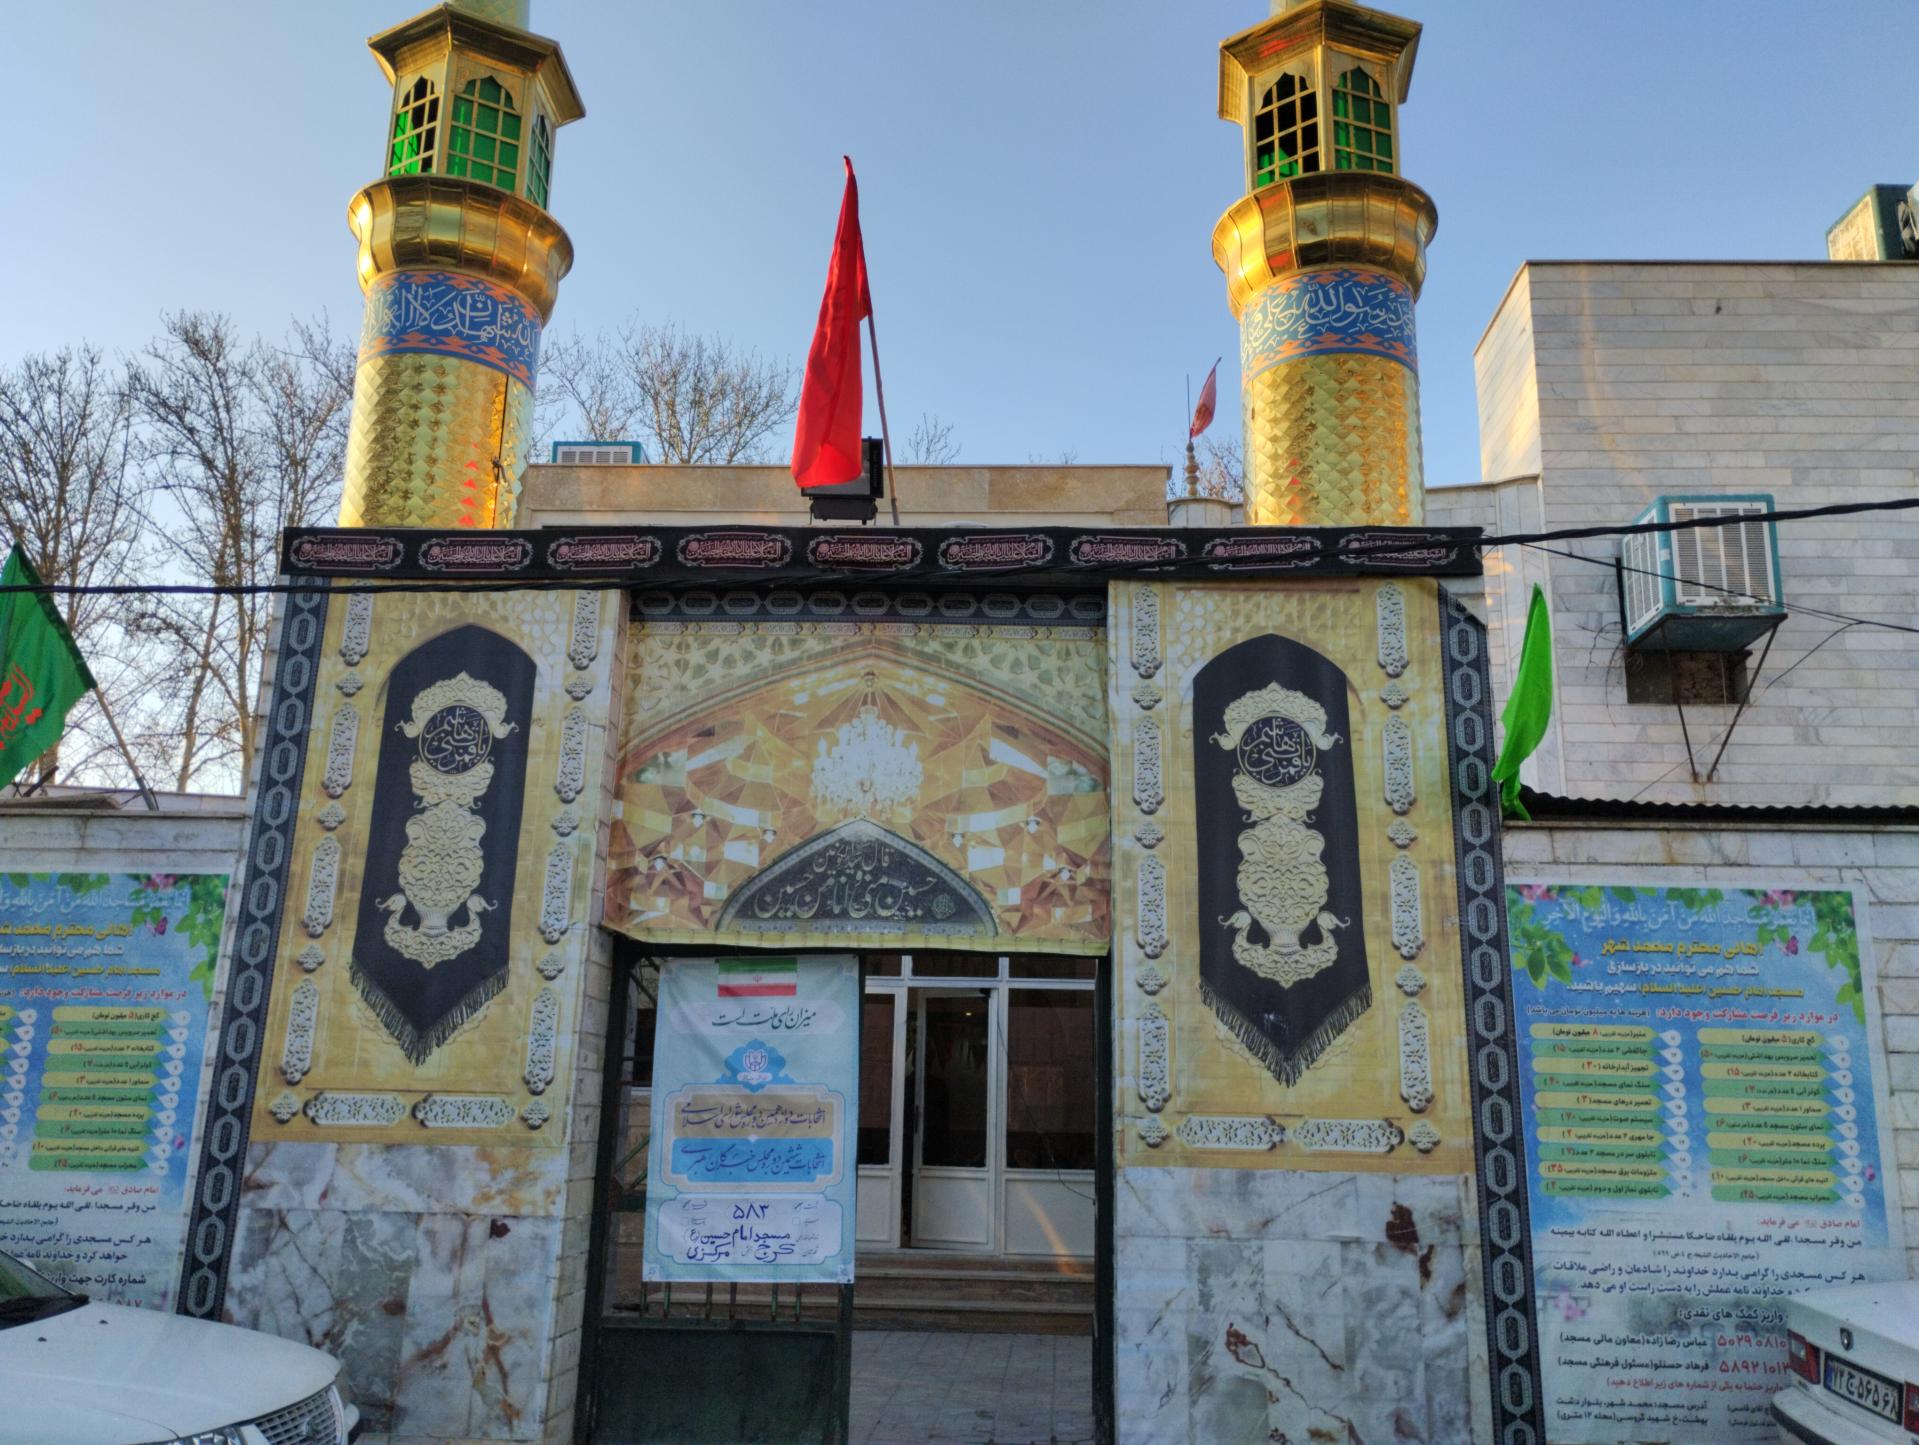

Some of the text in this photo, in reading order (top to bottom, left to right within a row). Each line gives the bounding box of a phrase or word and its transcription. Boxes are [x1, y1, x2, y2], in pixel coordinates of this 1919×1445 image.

[754, 874, 814, 918] حسین
[875, 876, 938, 920] حسین
[1601, 938, 1631, 956] شهر
[1632, 941, 1674, 954] محمد
[712, 1007, 746, 1026] است
[786, 1006, 817, 1029] میزان
[1799, 1010, 1826, 1023] موارد
[681, 1102, 726, 1128] اسلامی
[790, 1107, 826, 1129] انتخابات
[789, 1151, 825, 1175] انتخابات
[732, 1203, 770, 1220] ۵۸۳
[10, 1233, 36, 1246] بدارد
[36, 1232, 65, 1246] گرامی
[73, 1235, 113, 1247] مسجدی
[113, 1235, 136, 1248] کس
[138, 1235, 152, 1248] هر
[700, 1231, 731, 1245] حسین
[732, 1224, 753, 1248] امام
[753, 1231, 792, 1244] مسجد
[1846, 1238, 1863, 1248] من
[43, 1250, 75, 1262] خداوند
[82, 1250, 97, 1264] کرد
[99, 1250, 129, 1264] خواهد
[686, 1242, 732, 1263] مرکزی
[754, 1241, 796, 1264] کرج
[1552, 1260, 1587, 1272] ملاقات
[1588, 1263, 1616, 1277] راضی
[1625, 1263, 1662, 1276] شادمان
[1673, 1266, 1710, 1279] خداوند
[1712, 1266, 1739, 1280] بدارد
[68, 1273, 148, 1288] شماره کارت جهت
[1740, 1267, 1771, 1282] گرامی
[1780, 1270, 1823, 1282] مسجدی
[1825, 1271, 1848, 1284] کس
[1850, 1272, 1866, 1285] هر
[1602, 1284, 1618, 1294] می
[1628, 1281, 1656, 1295] راست
[1702, 1284, 1732, 1297] عملش
[1732, 1285, 1750, 1296] نامه
[1750, 1285, 1787, 1300] خداوند
[1711, 1308, 1733, 1321] های
[1735, 1308, 1760, 1321] کمک
[1761, 1309, 1784, 1325] واریز
[1593, 1333, 1613, 1347] مالی
[1682, 1337, 1708, 1349] عباس
